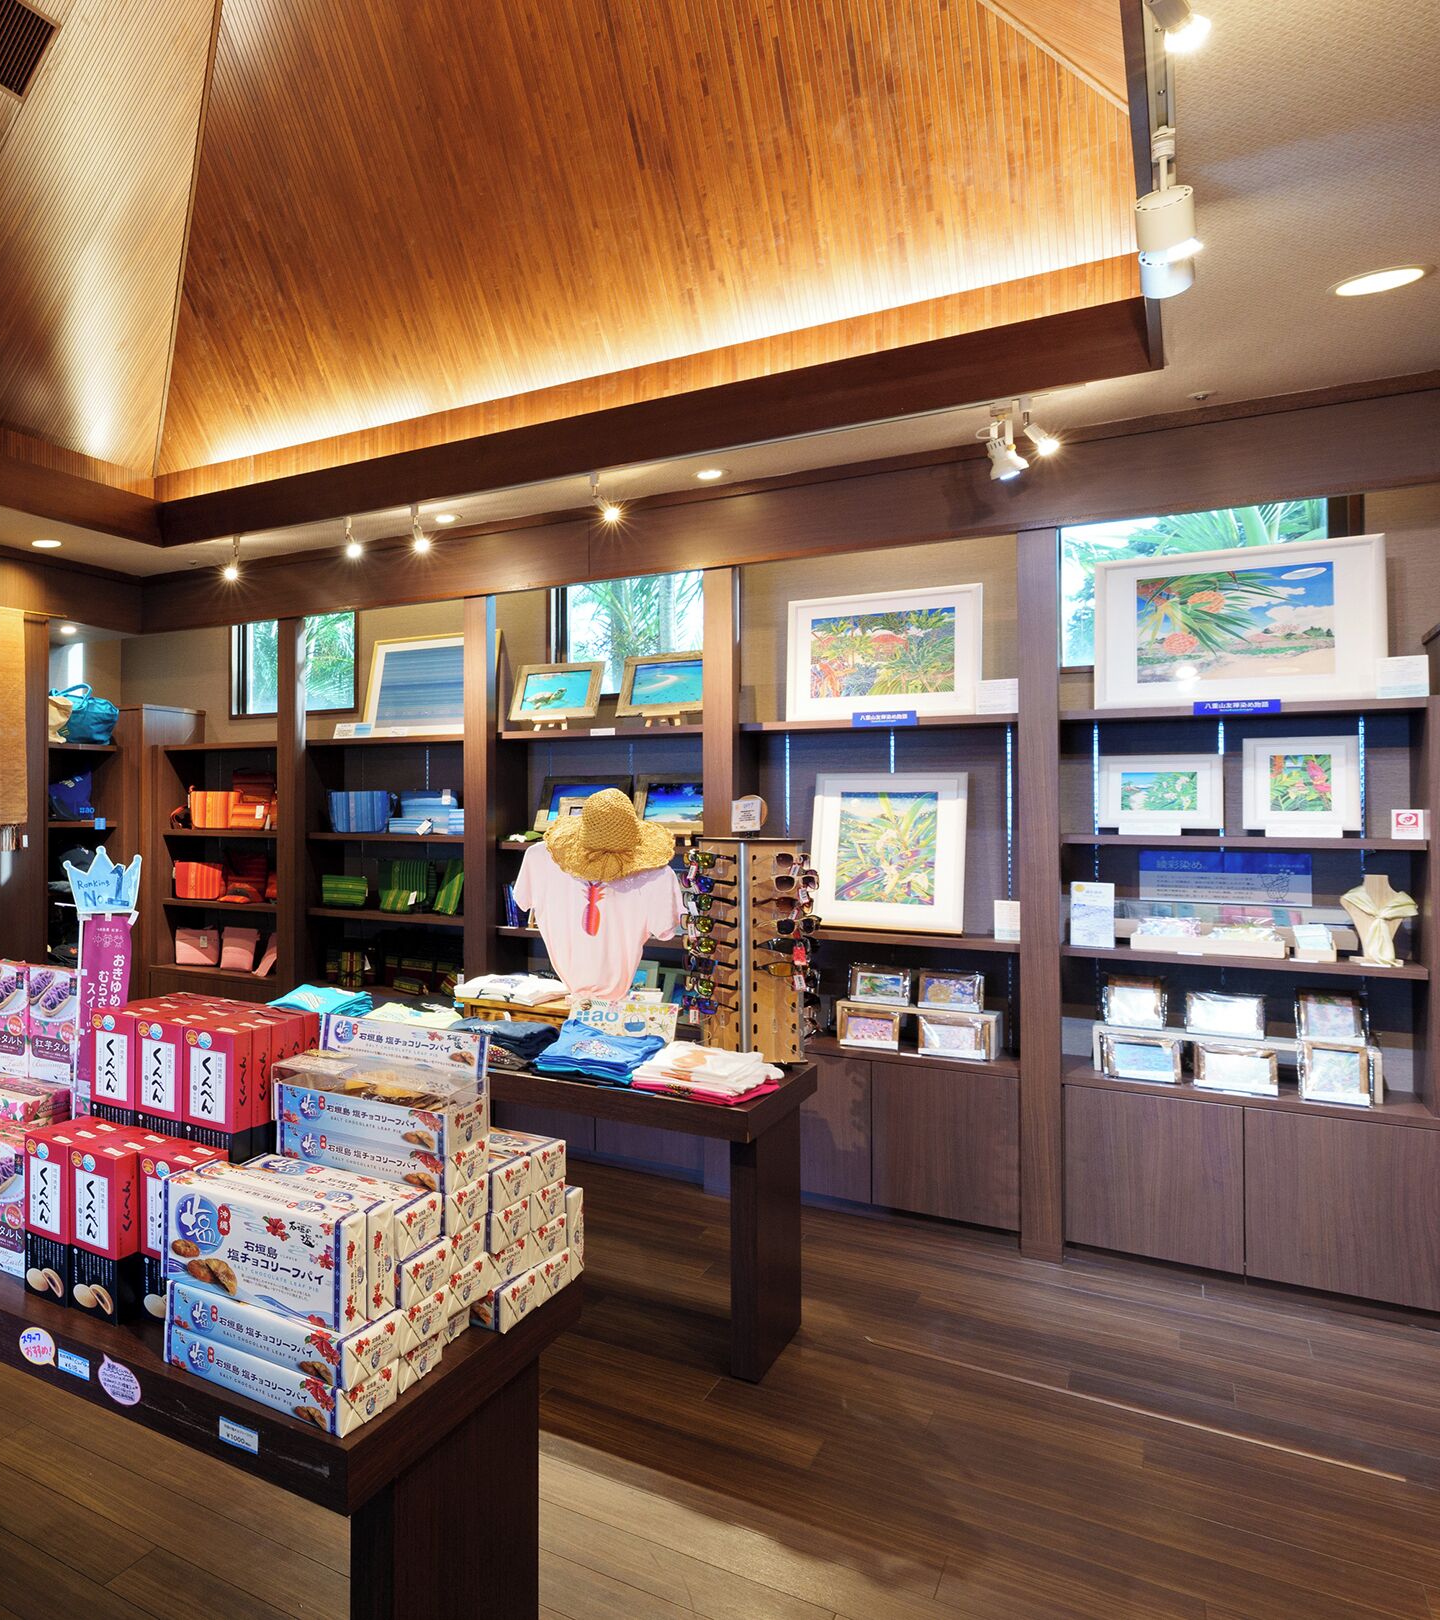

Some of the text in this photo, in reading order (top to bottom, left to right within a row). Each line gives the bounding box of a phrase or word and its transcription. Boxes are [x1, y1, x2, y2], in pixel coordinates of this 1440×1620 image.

[77, 880, 110, 890] Ranking
[35, 1038, 69, 1052] 紅芋タル
[327, 1105, 416, 1129] 石垣島 塩チョコリーフパイ
[328, 1144, 417, 1170] 石垣島 塩チョコリーフパイ
[244, 1241, 278, 1259] 石垣島
[227, 1249, 324, 1286] 塩チョコリーフパイ
[218, 1316, 313, 1358] 石垣島 塩チョコリーフパイ
[215, 1358, 308, 1403] 石垣島 塩チョコリーフパイ
